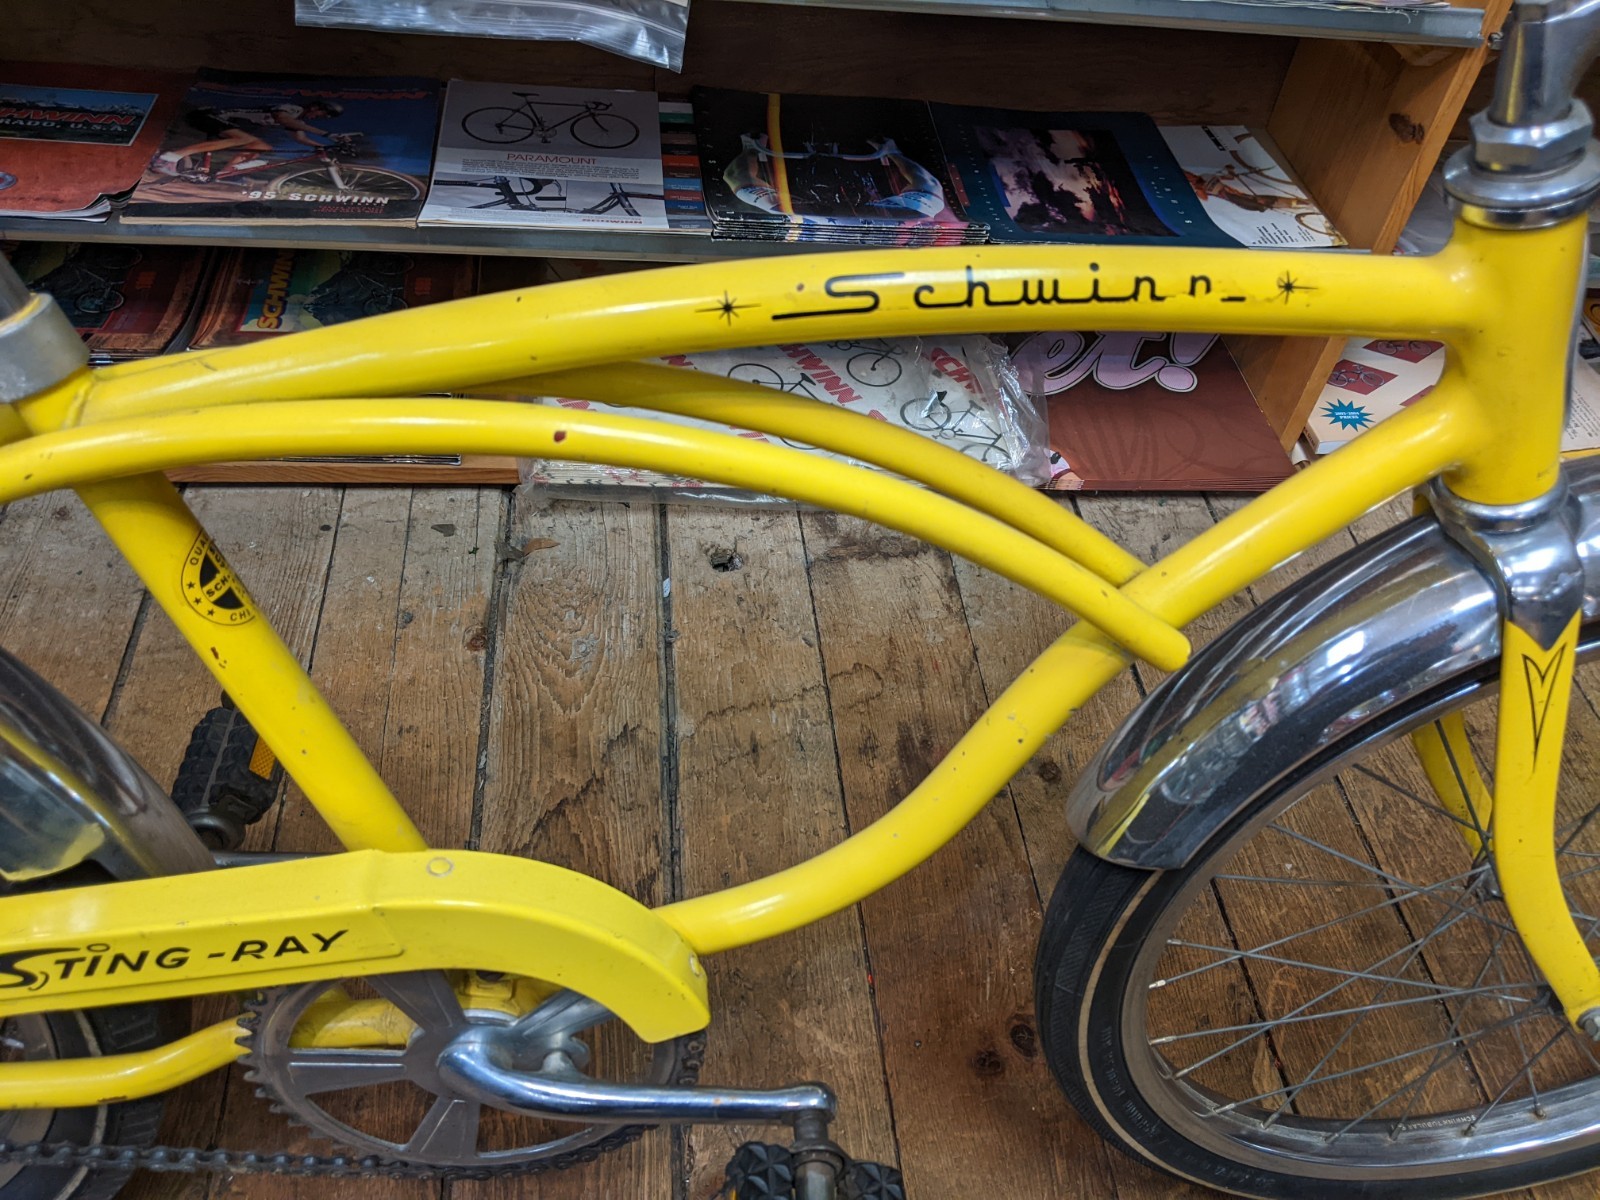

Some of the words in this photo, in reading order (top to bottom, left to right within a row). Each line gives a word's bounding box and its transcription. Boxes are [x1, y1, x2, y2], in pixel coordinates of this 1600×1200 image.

[507, 153, 597, 165] PARAMOUNT
[242, 190, 277, 199] '95
[289, 193, 390, 205] SCHWINN
[772, 264, 1246, 320] Schwinn
